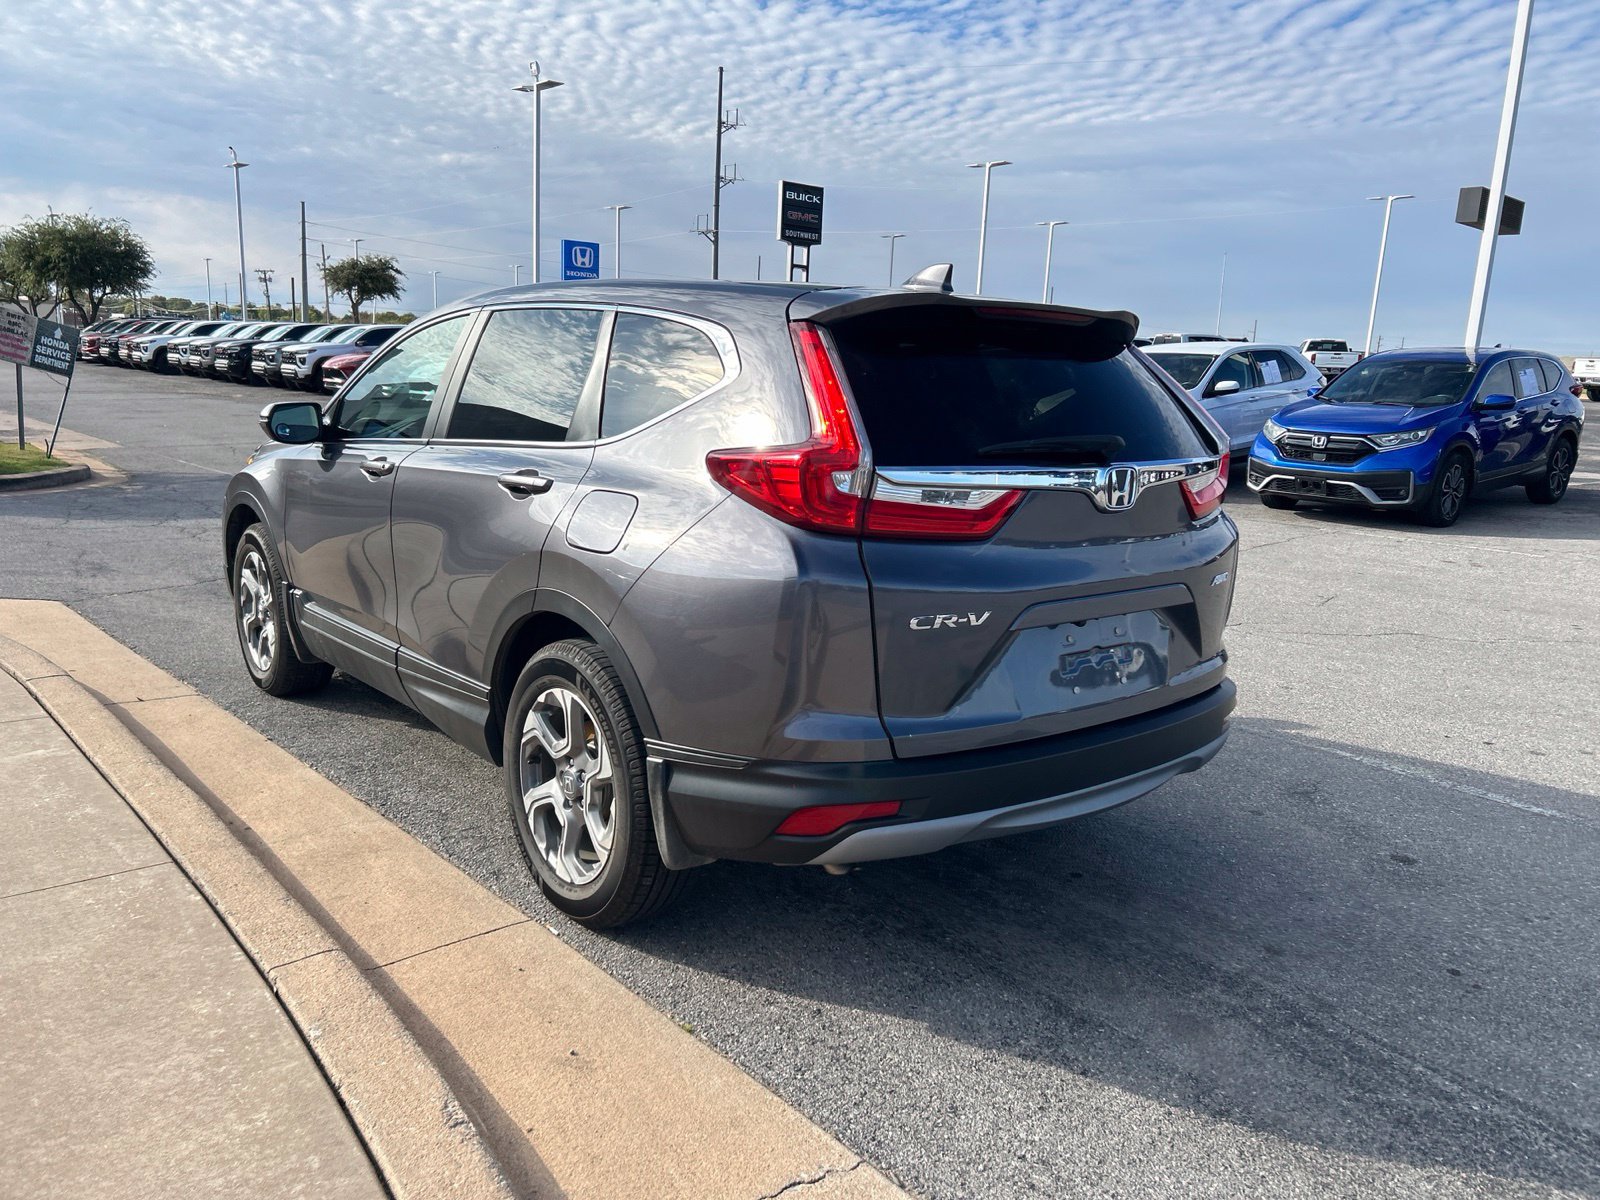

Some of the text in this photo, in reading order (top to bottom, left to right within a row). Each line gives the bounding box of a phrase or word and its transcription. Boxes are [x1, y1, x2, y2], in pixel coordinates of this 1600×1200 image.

[786, 191, 821, 203] BUICK
[787, 211, 818, 222] GMC
[785, 229, 819, 240] SOUTHWEST
[566, 270, 598, 278] HONDA
[41, 336, 70, 351] HONDA
[36, 345, 71, 361] SERVICE
[34, 354, 70, 370] DEPARTMENT
[909, 610, 993, 630] CR-V
[590, 697, 620, 767] MICHELIN
